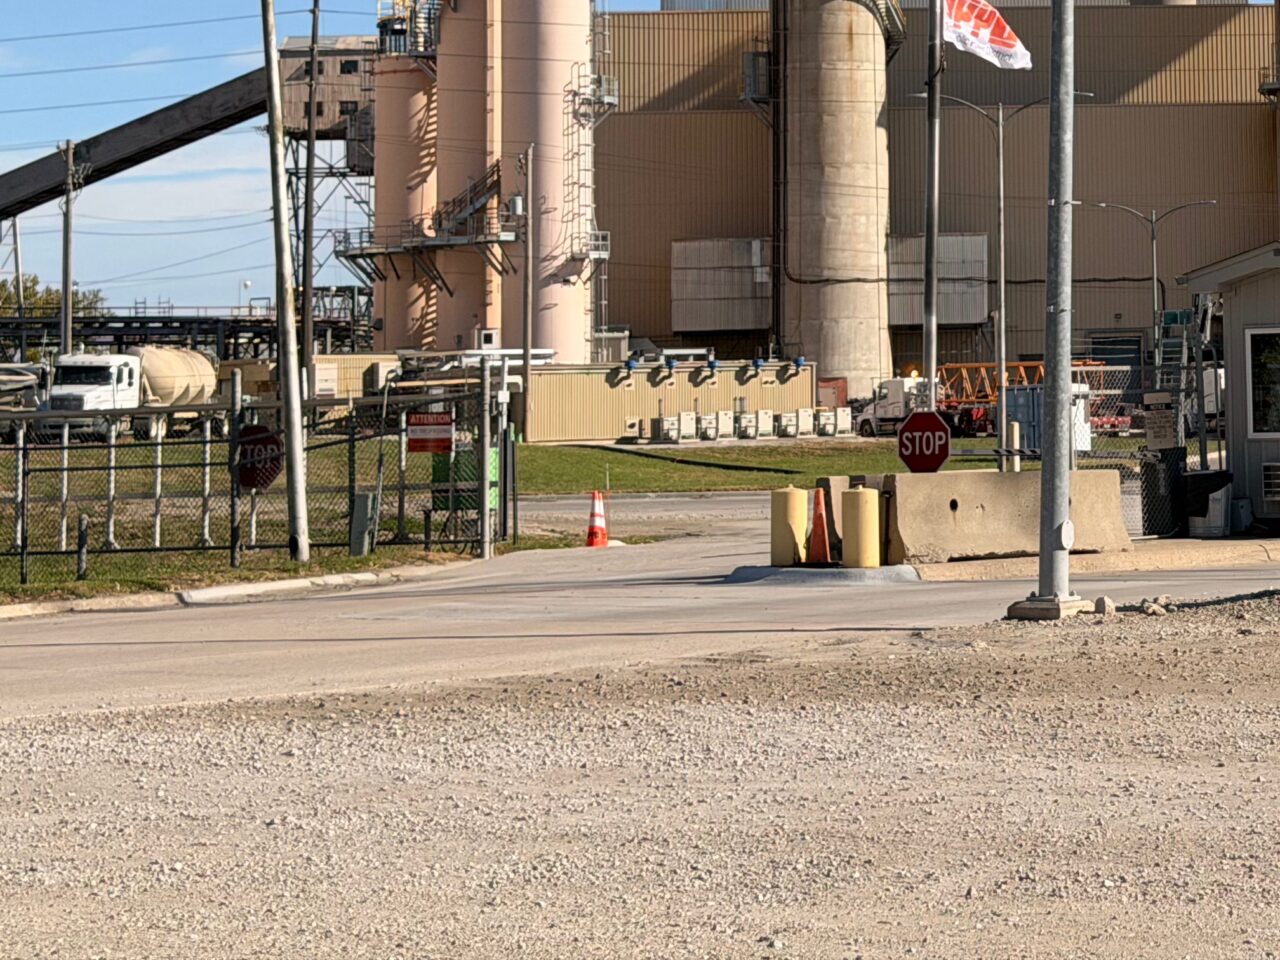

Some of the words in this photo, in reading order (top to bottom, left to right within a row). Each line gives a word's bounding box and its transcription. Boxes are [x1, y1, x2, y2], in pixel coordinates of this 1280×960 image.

[410, 413, 451, 425] ATTENTION
[242, 443, 279, 469] TOP
[901, 431, 947, 456] STOP
